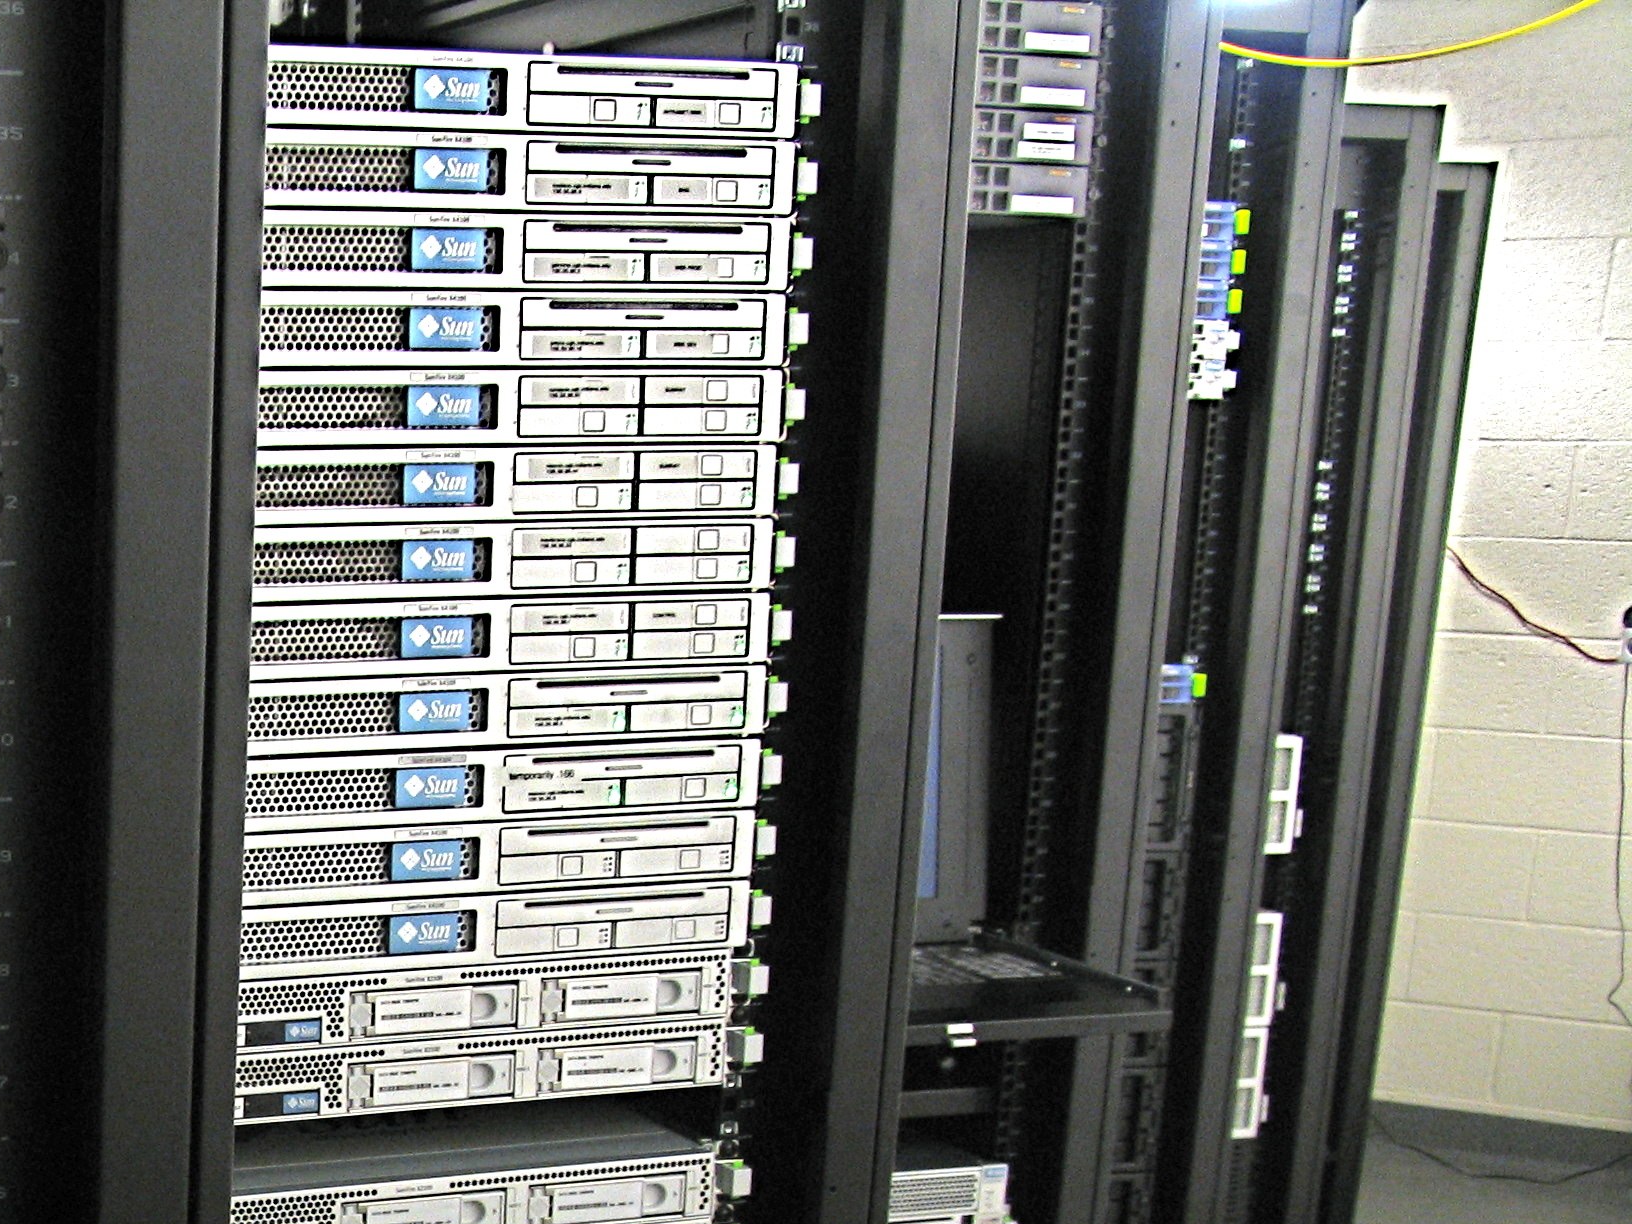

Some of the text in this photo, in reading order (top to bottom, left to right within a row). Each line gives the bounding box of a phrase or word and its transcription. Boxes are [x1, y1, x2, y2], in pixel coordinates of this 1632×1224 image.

[444, 77, 480, 98] Sun
[444, 157, 480, 178] Sun
[441, 237, 477, 257] Sun
[439, 317, 474, 336] Sun
[437, 394, 472, 413] Sun
[433, 472, 467, 492] Sun
[431, 548, 465, 568] Sun
[430, 626, 464, 644] Sun
[428, 700, 461, 719] Sun
[425, 776, 457, 795] Sun
[421, 849, 453, 868] Sun
[418, 922, 450, 941] Sun
